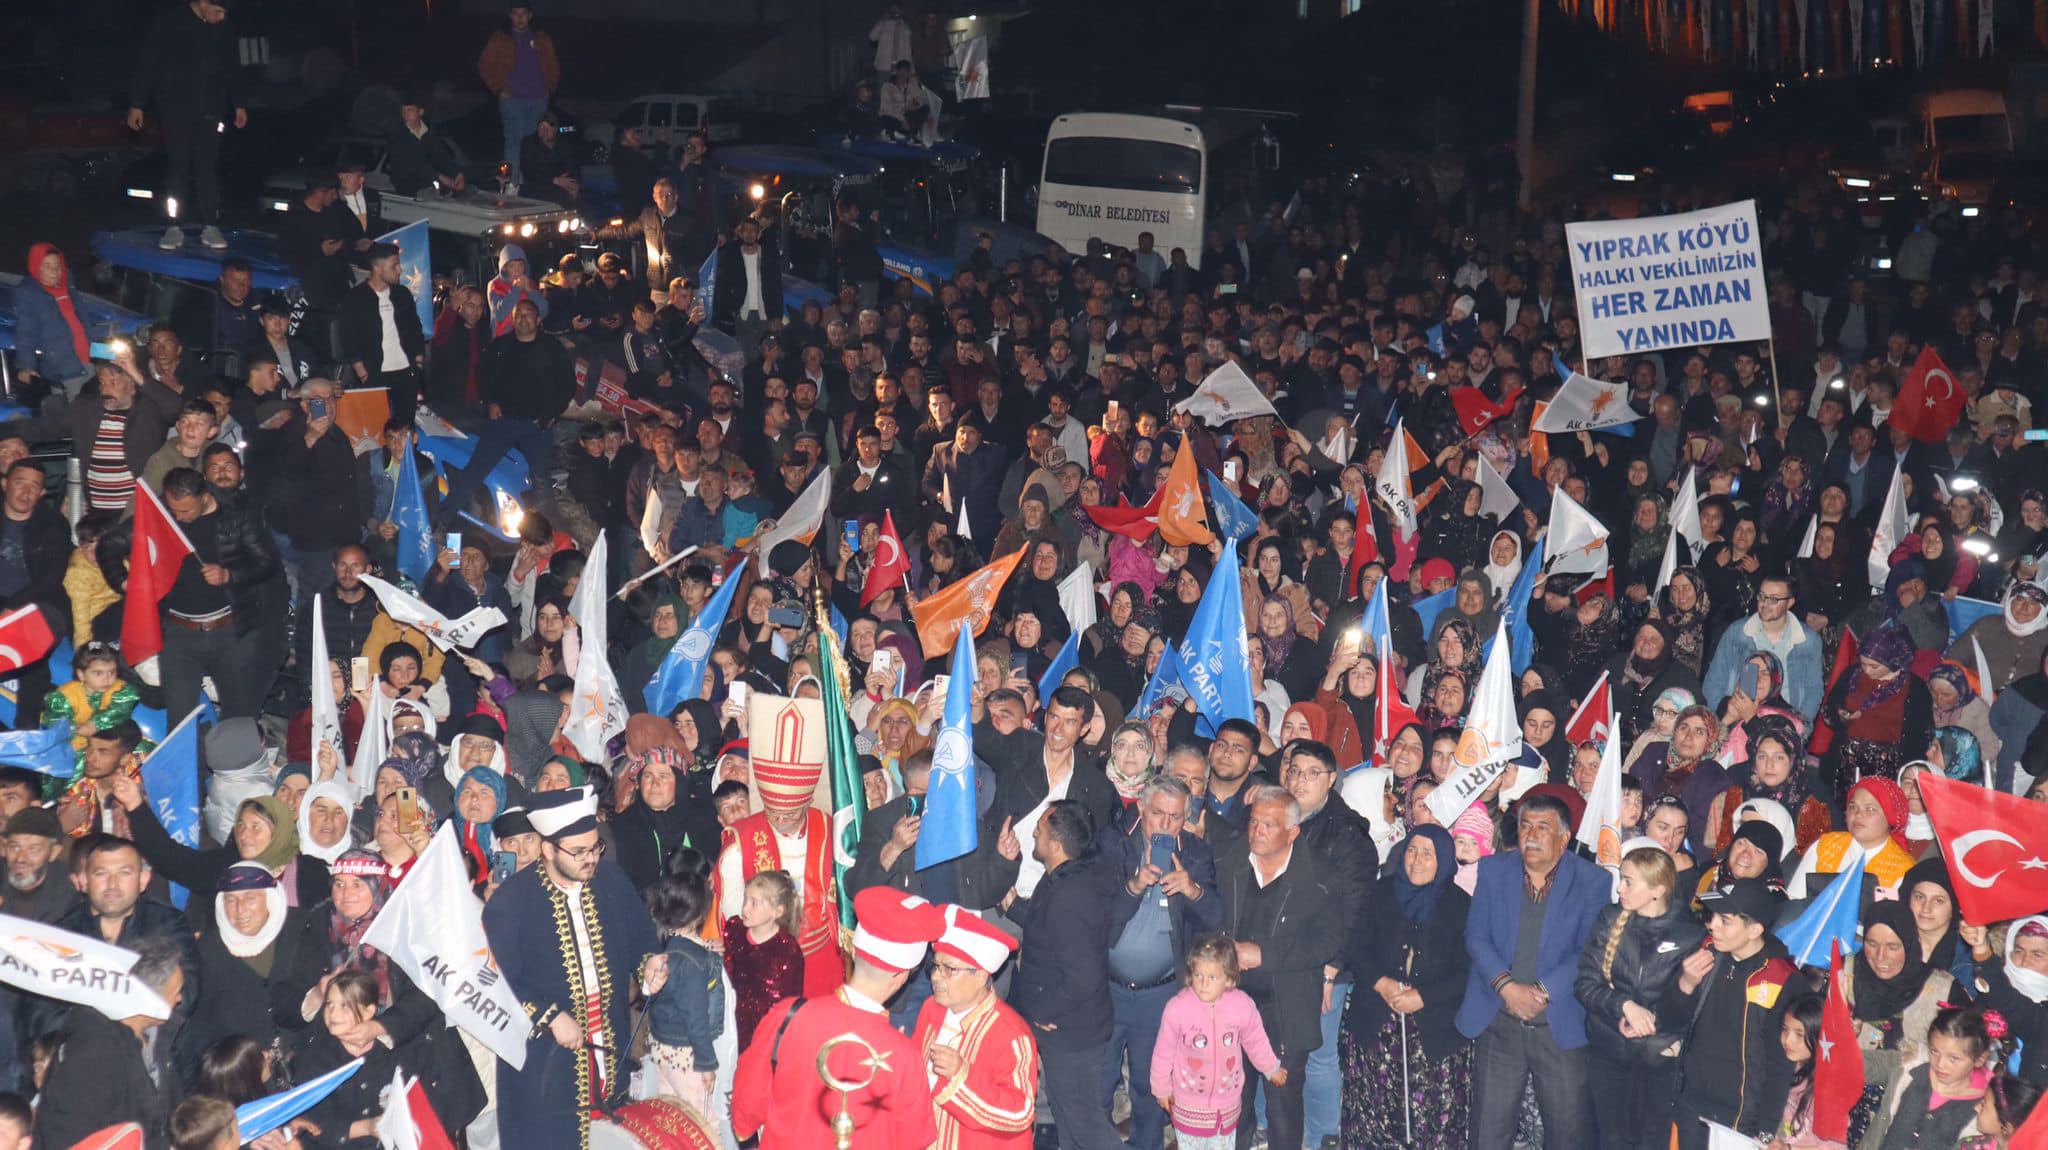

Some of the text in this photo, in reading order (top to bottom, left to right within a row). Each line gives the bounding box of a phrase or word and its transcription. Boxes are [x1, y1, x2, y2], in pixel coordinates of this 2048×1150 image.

[1068, 201, 1101, 218] DİNAR
[1106, 206, 1170, 224] BELEDİYESİ
[1577, 217, 1750, 263] YIPRAK KÖYÜ
[1579, 250, 1757, 289] HALKI VEKİLİMİZİN
[1591, 278, 1752, 319] HER ZAMAN
[1616, 317, 1736, 351] YANINDA
[1381, 482, 1398, 499] AK
[1179, 639, 1197, 665] AK
[157, 797, 177, 829] AK
[421, 955, 457, 987] AK
